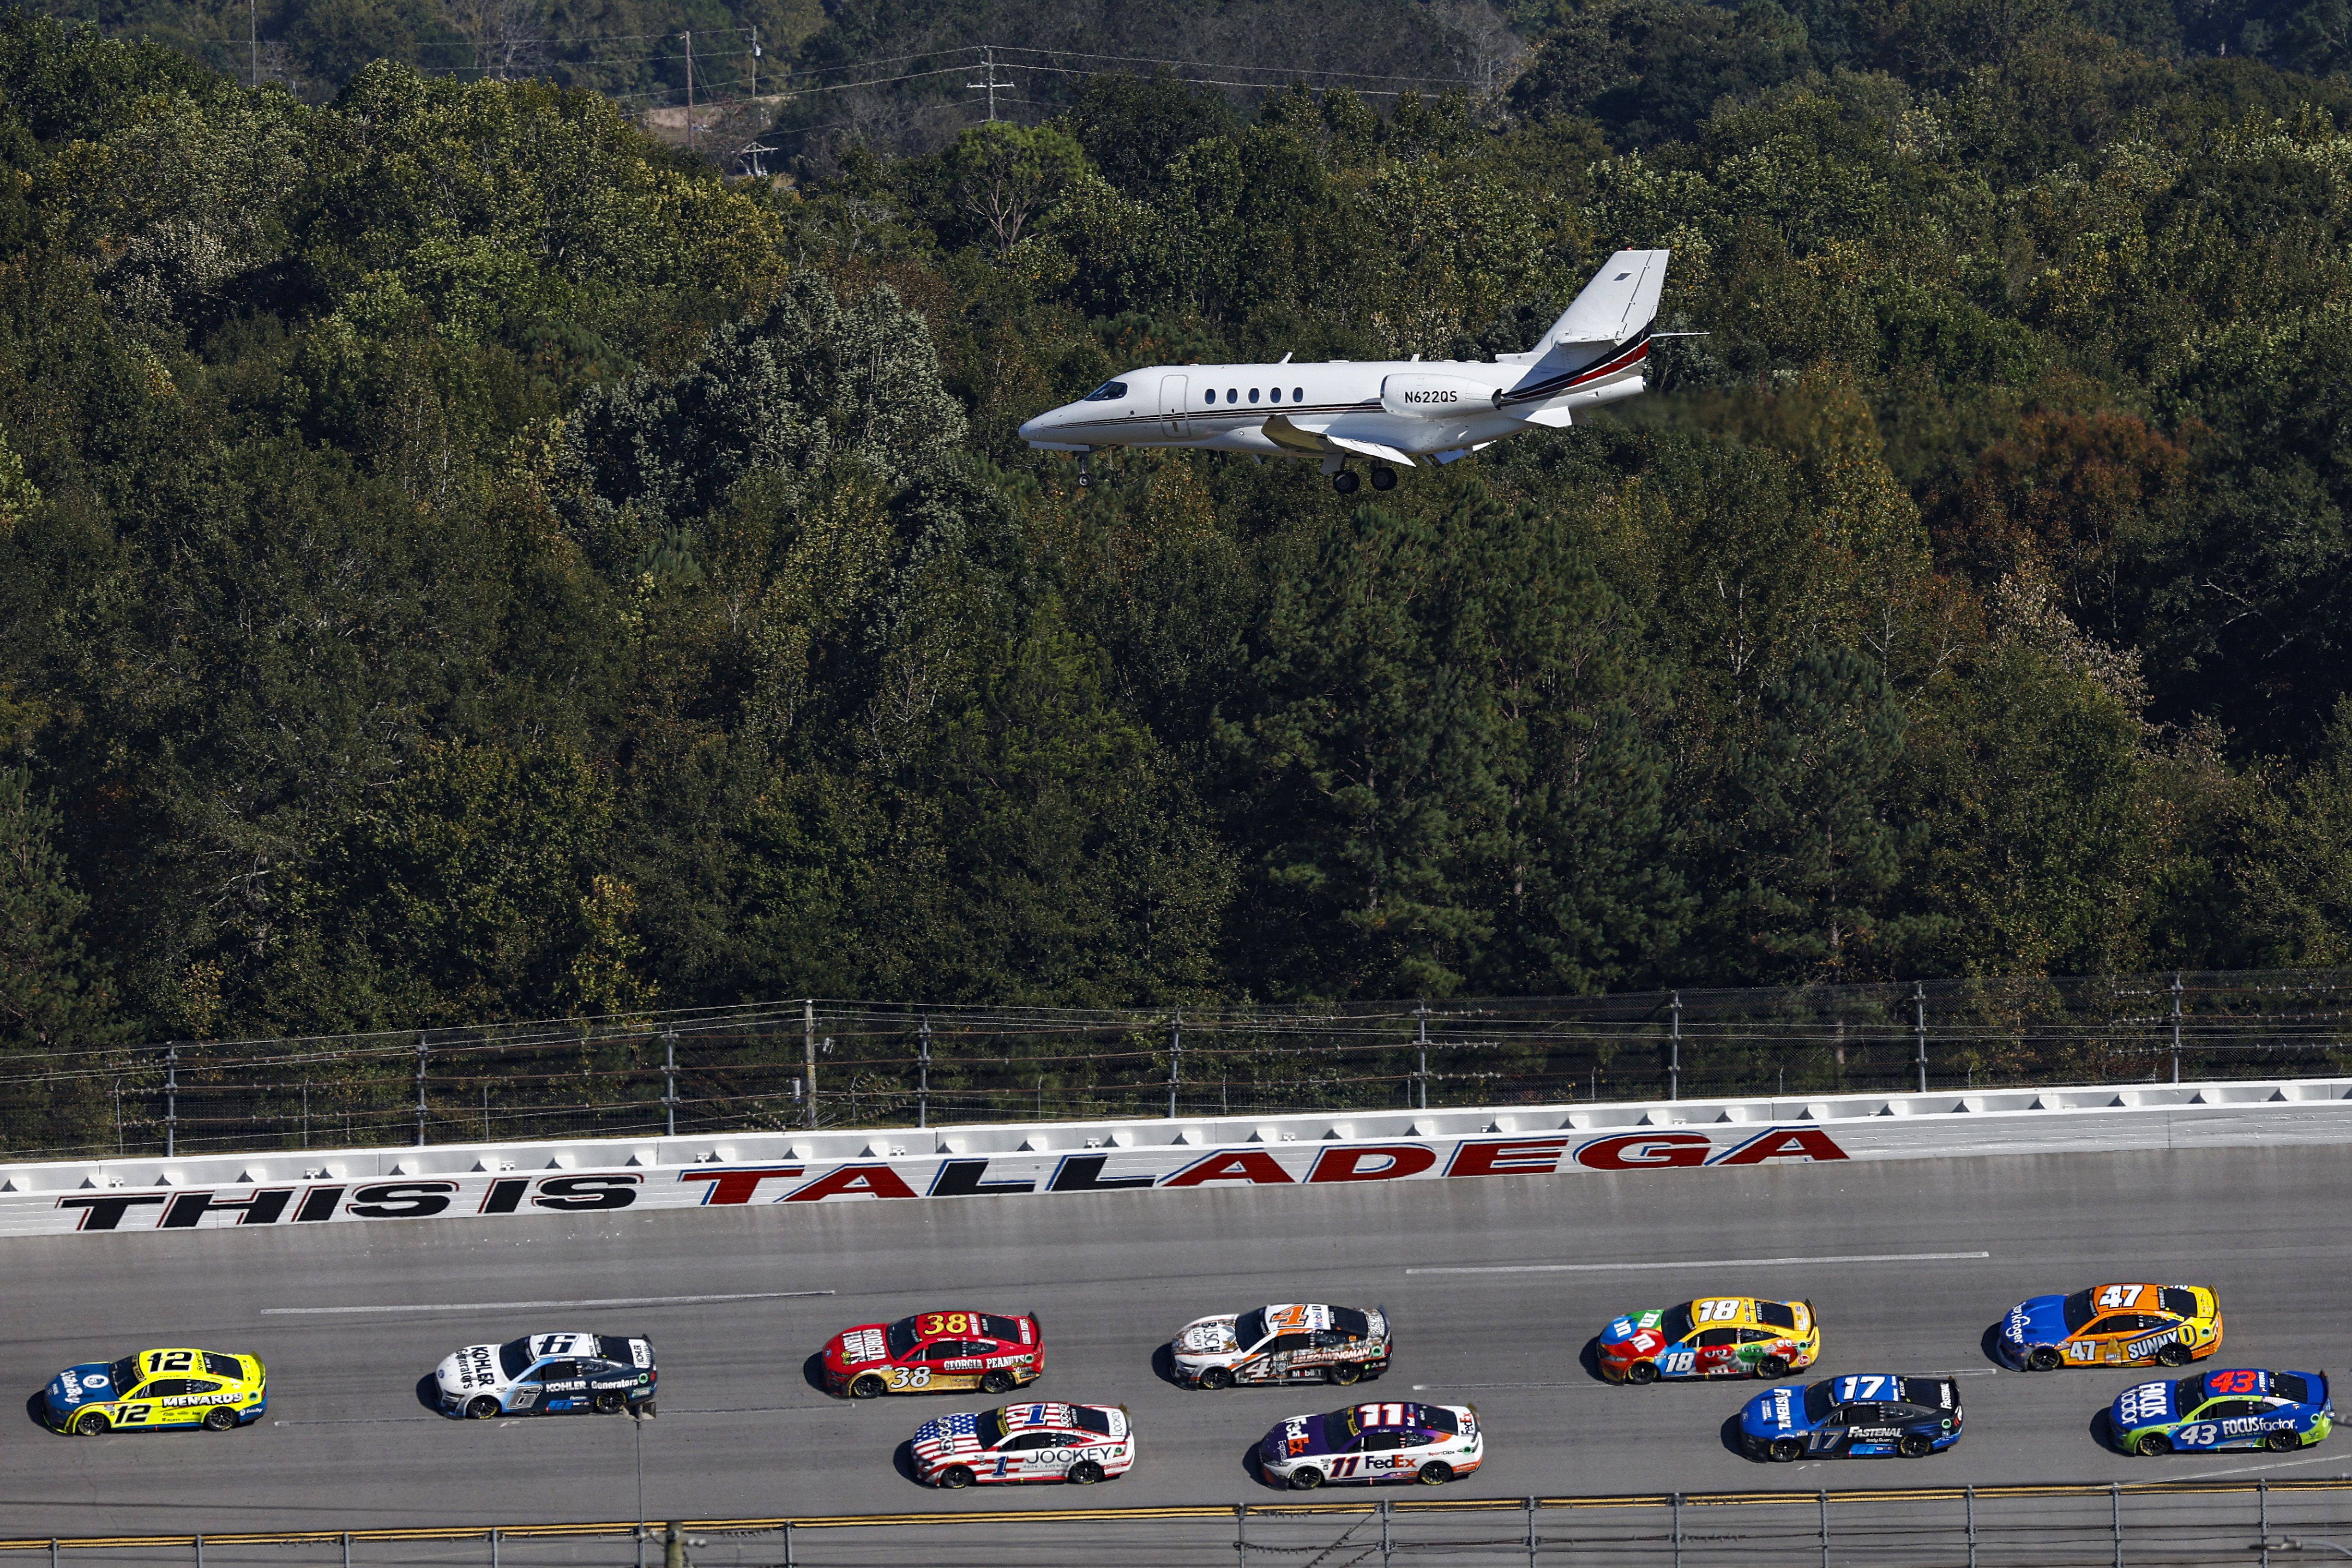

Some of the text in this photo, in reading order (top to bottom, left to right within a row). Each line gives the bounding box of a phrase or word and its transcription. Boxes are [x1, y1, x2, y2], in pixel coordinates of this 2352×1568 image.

[1405, 391, 1457, 403] N622QS
[56, 1124, 1851, 1231] THIS IS TALLADEGA
[2099, 1285, 2144, 1308] 47
[1270, 1304, 1310, 1328] 4
[1312, 1311, 1323, 1329] Mobil
[1699, 1299, 1740, 1323] 18
[924, 1313, 968, 1335] 38
[2005, 1315, 2031, 1344] Kroger
[538, 1335, 577, 1356] 6
[862, 1328, 887, 1362] GEORGIA
[1201, 1321, 1221, 1353] BUSCH
[148, 1351, 193, 1373] 12
[944, 1354, 1025, 1370] GEORGIA PEANUTS
[2069, 1340, 2097, 1361] 47
[455, 1348, 474, 1389] Generators
[471, 1346, 495, 1387] KOHLER
[1245, 1358, 1270, 1379] 4
[1665, 1352, 1695, 1373] 18
[546, 1379, 638, 1393] KOHLER Generators
[890, 1366, 932, 1389] 38
[1843, 1376, 1886, 1400] 17
[2210, 1370, 2257, 1393] 43
[162, 1393, 243, 1408] MENARDS
[507, 1384, 543, 1410] 6
[1940, 1382, 1952, 1410] FASTENAL
[2121, 1389, 2141, 1425] factor
[2138, 1382, 2168, 1418] FOCUS
[114, 1404, 151, 1424] 12
[1022, 1403, 1047, 1427] 1
[1059, 1403, 1071, 1428] JOCKEY
[1359, 1403, 1404, 1428] 11
[1774, 1388, 1792, 1430] FASTENAL
[1112, 1410, 1123, 1436] JOCKEY
[1459, 1412, 1474, 1435] FedEx
[1847, 1425, 1902, 1438] FASTENAL
[2180, 1424, 2218, 1445] 43
[937, 1417, 956, 1455] JOCKEY
[1285, 1418, 1310, 1456] FedEx
[1809, 1430, 1846, 1450] 17
[991, 1455, 1009, 1478] 1
[1026, 1447, 1112, 1464] JOCKEY
[1329, 1455, 1360, 1478] 11
[1365, 1454, 1417, 1469] FedEx
